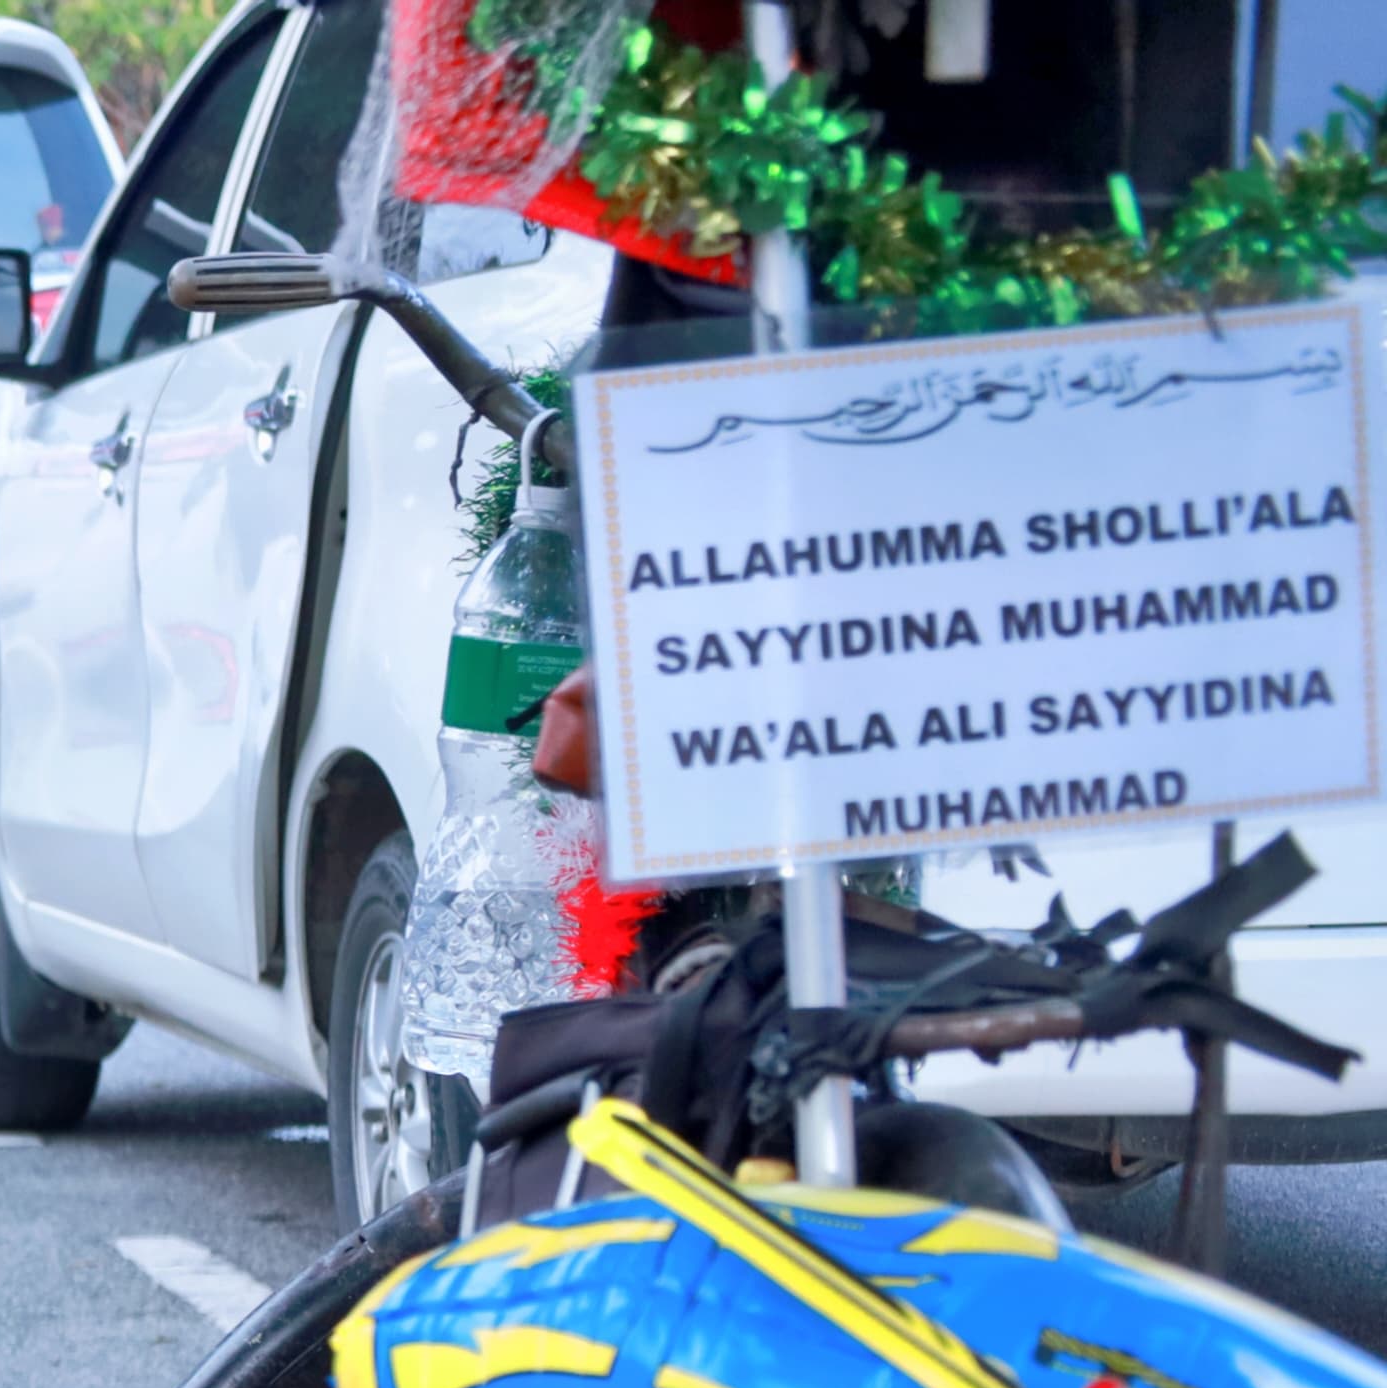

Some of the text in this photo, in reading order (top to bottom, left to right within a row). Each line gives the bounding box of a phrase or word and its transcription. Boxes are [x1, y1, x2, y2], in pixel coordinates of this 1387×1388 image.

[628, 485, 1357, 592] ALLAHUMMA SHOLLI'ALA
[655, 572, 1339, 676] SAYYIDINA MUHAMMAD
[670, 668, 1334, 768] WA'ALA ALI SAYYIDINA
[843, 769, 1188, 839] MUHAMMAD
